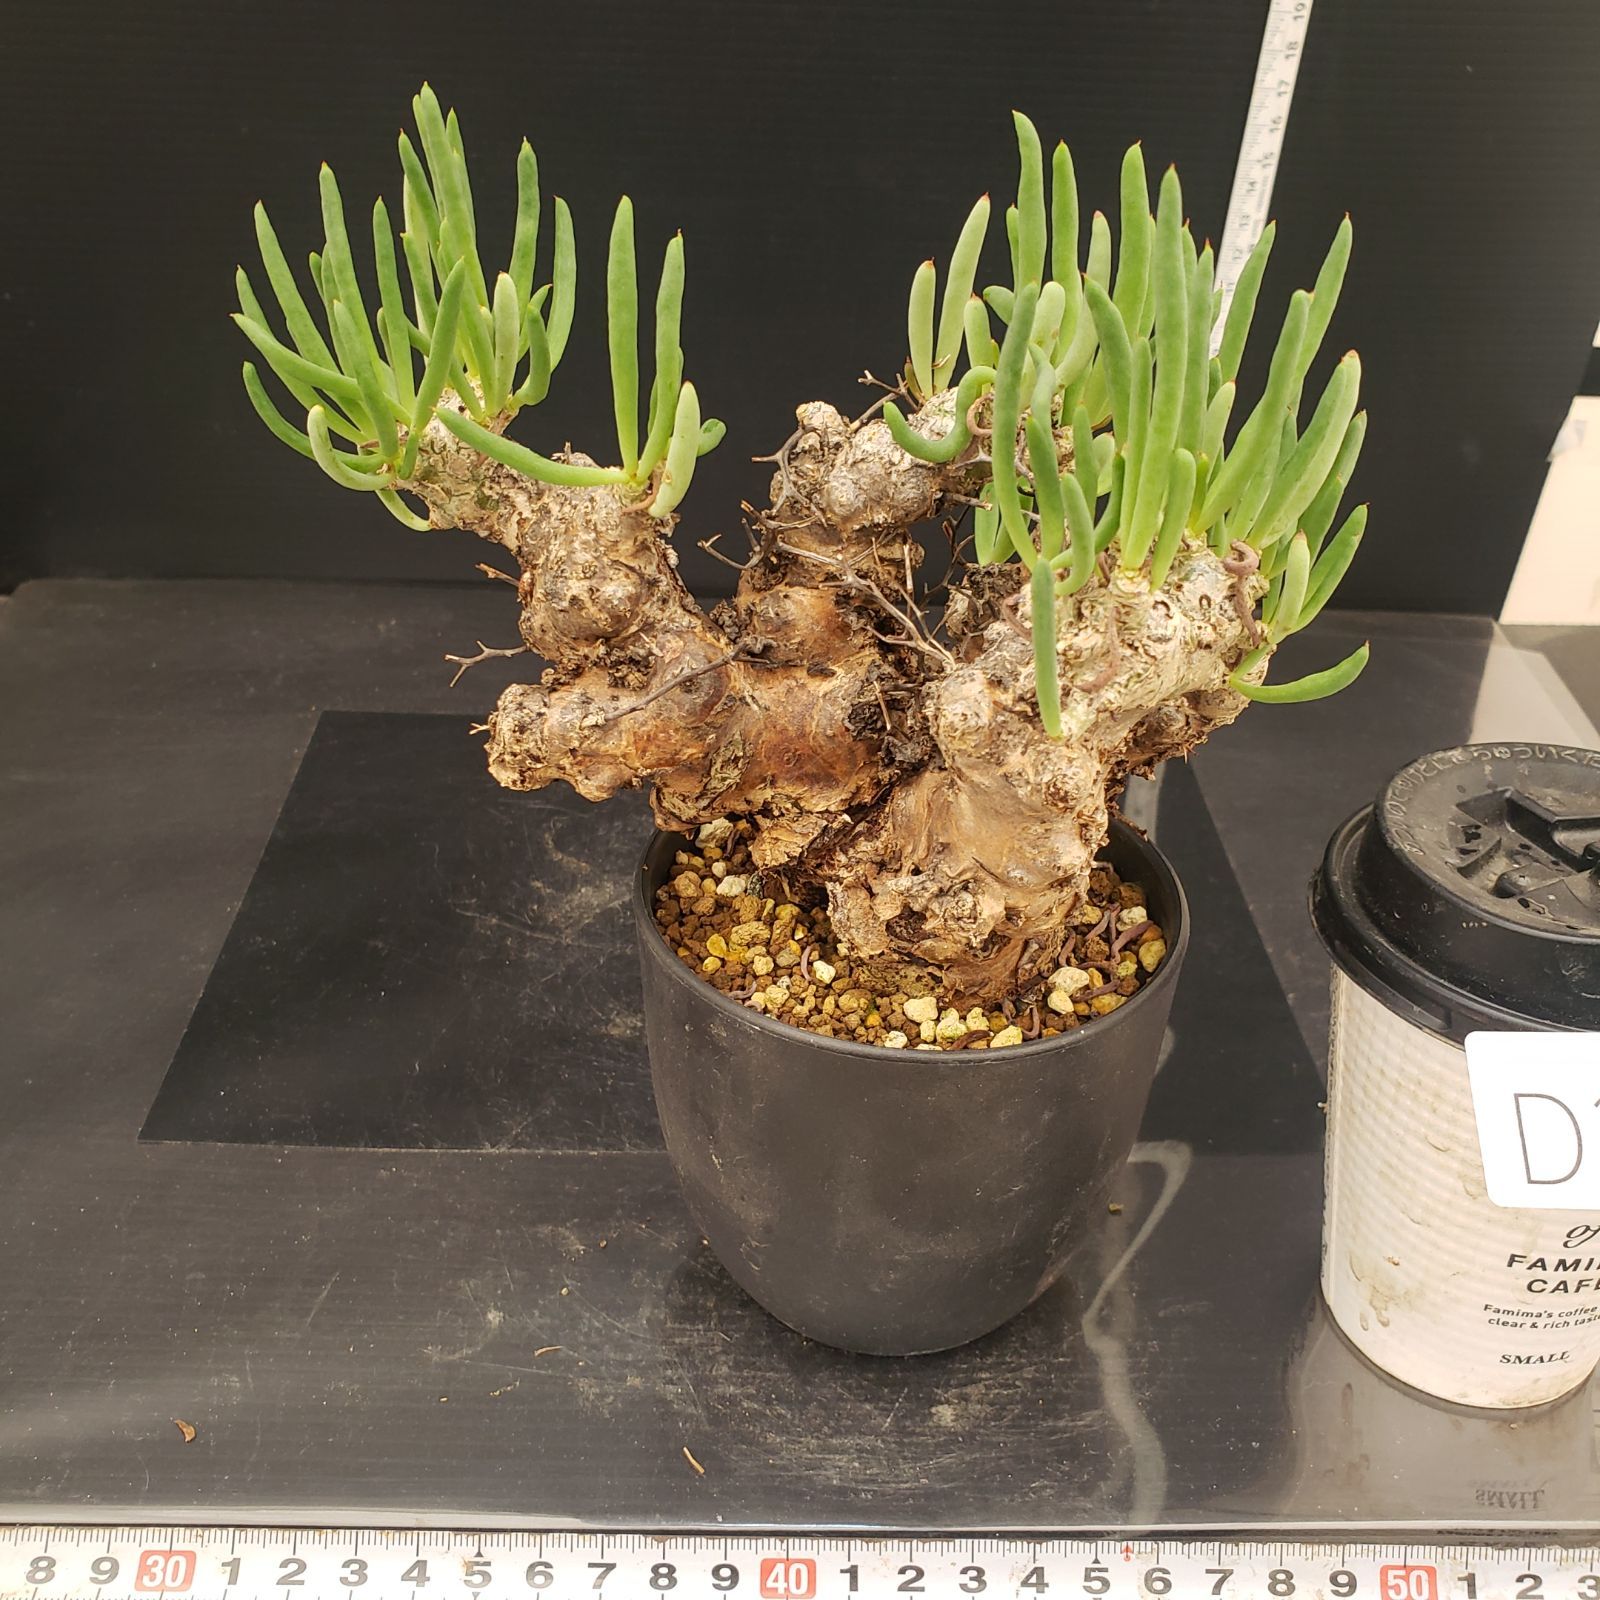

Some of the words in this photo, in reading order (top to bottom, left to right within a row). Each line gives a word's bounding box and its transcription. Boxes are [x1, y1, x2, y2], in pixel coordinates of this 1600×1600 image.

[1277, 79, 1290, 97] 17
[1284, 41, 1299, 60] 18
[1293, 2, 1306, 21] 19
[1514, 1093, 1600, 1184] D
[1507, 1253, 1600, 1272] FAMI
[1484, 1304, 1554, 1319] Famima's
[1558, 1306, 1598, 1318] coffee
[1488, 1317, 1527, 1329] clear
[1529, 1321, 1539, 1329] &
[1543, 1320, 1570, 1329] rich
[1500, 1350, 1571, 1365] SMALL
[25, 1556, 57, 1585] 8
[88, 1556, 120, 1585] 9
[142, 1555, 187, 1588] 30
[221, 1557, 242, 1586] 1
[276, 1558, 308, 1587] 2
[339, 1558, 369, 1587] 3
[401, 1559, 431, 1588] 4
[463, 1561, 492, 1589] 5
[525, 1561, 554, 1589] 6
[587, 1562, 617, 1590] 7
[649, 1563, 678, 1591] 8
[711, 1563, 740, 1591] 9
[766, 1562, 806, 1596] 40
[839, 1564, 859, 1592] 1
[897, 1565, 925, 1592] 2
[958, 1565, 987, 1593] 3
[1020, 1566, 1049, 1594] 4
[1082, 1567, 1111, 1595] 5
[1143, 1567, 1172, 1595] 6
[1205, 1568, 1234, 1596] 7
[1267, 1569, 1296, 1597] 8
[1328, 1570, 1357, 1598] 9
[1387, 1569, 1429, 1600] 50
[1457, 1572, 1477, 1600] 1
[1515, 1573, 1543, 1600] 2
[1577, 1574, 1600, 1600] 3
